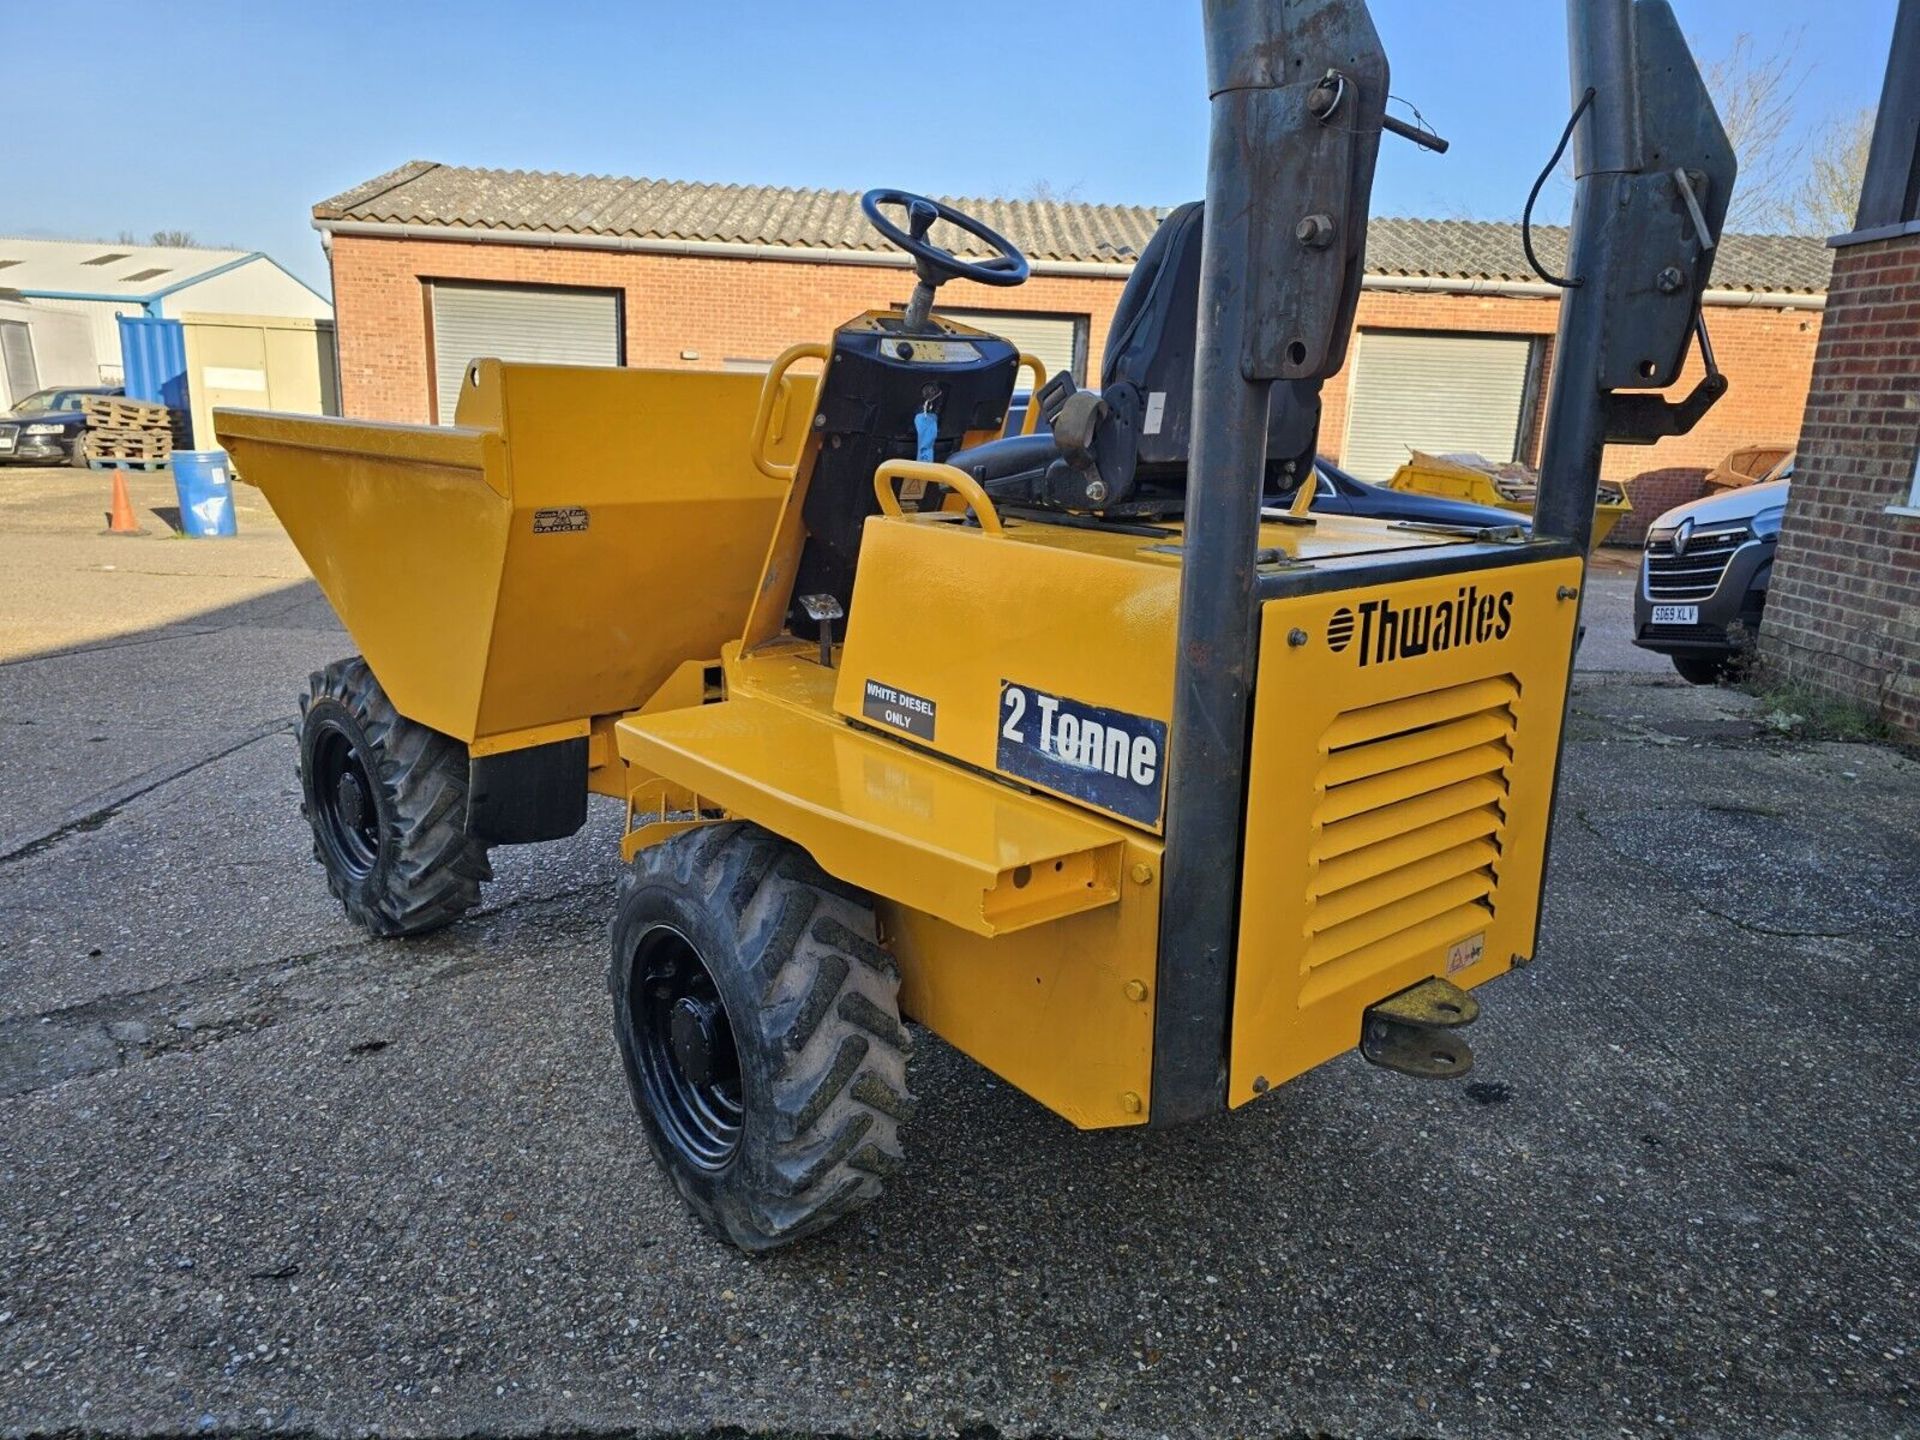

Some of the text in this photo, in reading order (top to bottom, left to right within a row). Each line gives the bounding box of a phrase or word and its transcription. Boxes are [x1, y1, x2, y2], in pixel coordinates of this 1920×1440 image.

[1358, 585, 1514, 668] Thwaites
[1655, 607, 1675, 621] SD69
[867, 682, 934, 717] WHITE DIESEL
[885, 709, 912, 729] ONLY
[1002, 687, 1157, 786] 2 Tonne
